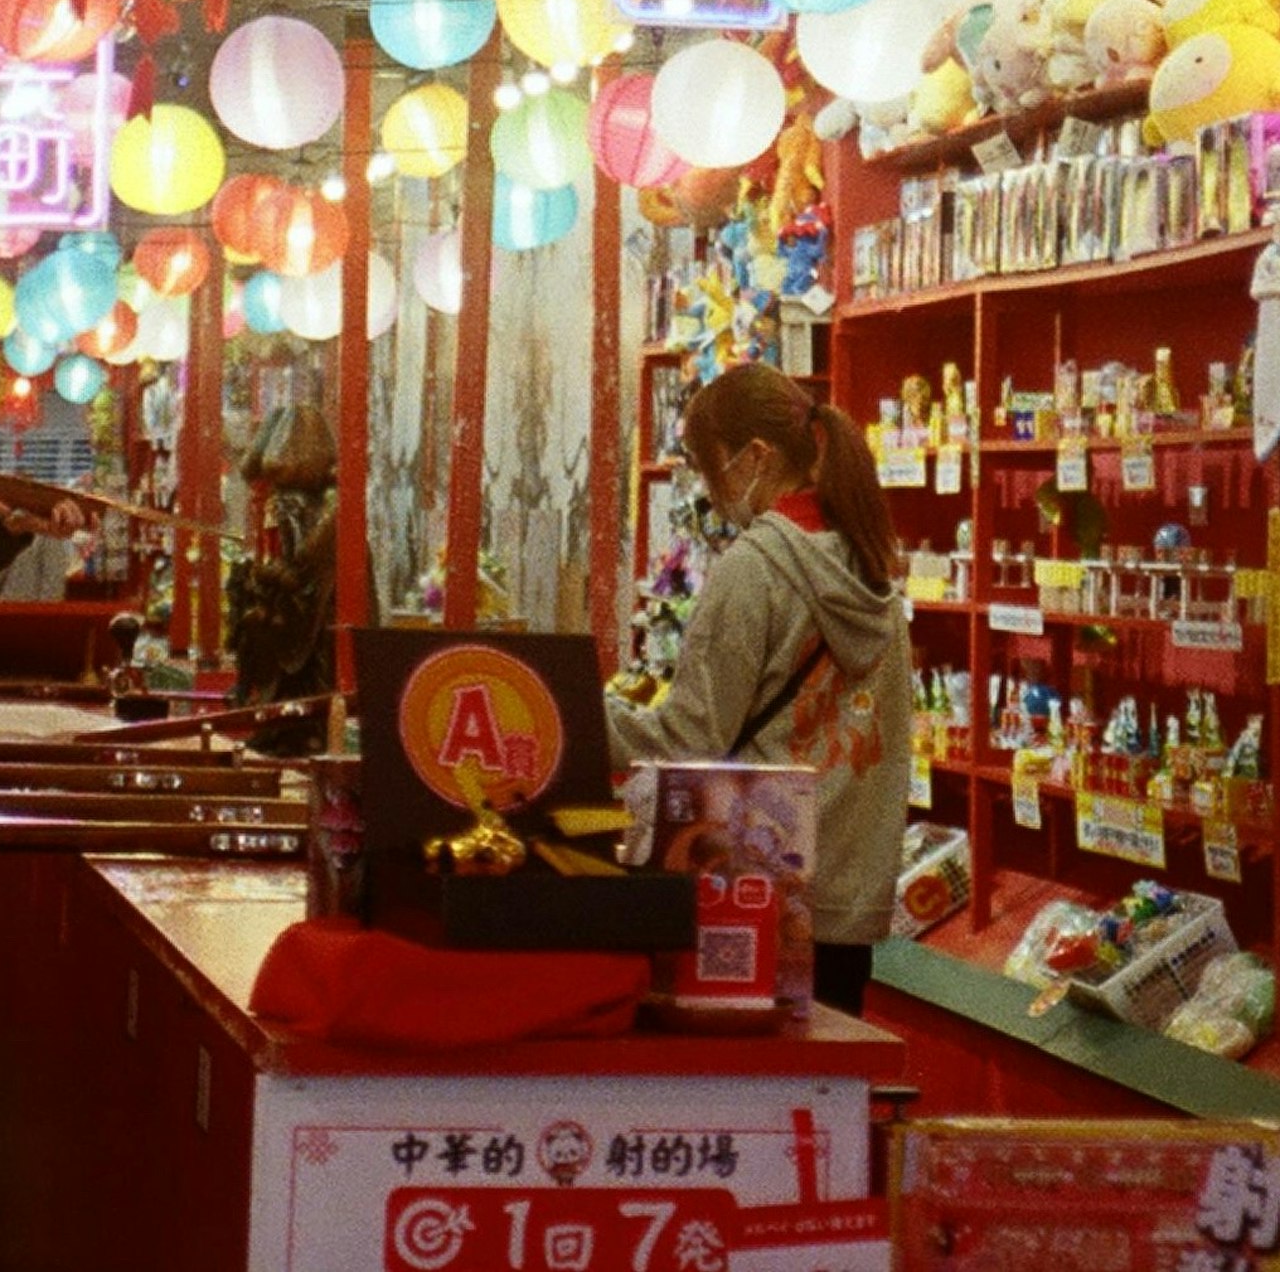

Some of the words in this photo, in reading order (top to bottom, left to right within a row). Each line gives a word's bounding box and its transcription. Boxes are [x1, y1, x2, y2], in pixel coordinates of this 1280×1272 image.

[391, 1134, 526, 1177] 中華的
[603, 1132, 741, 1178] 射的場
